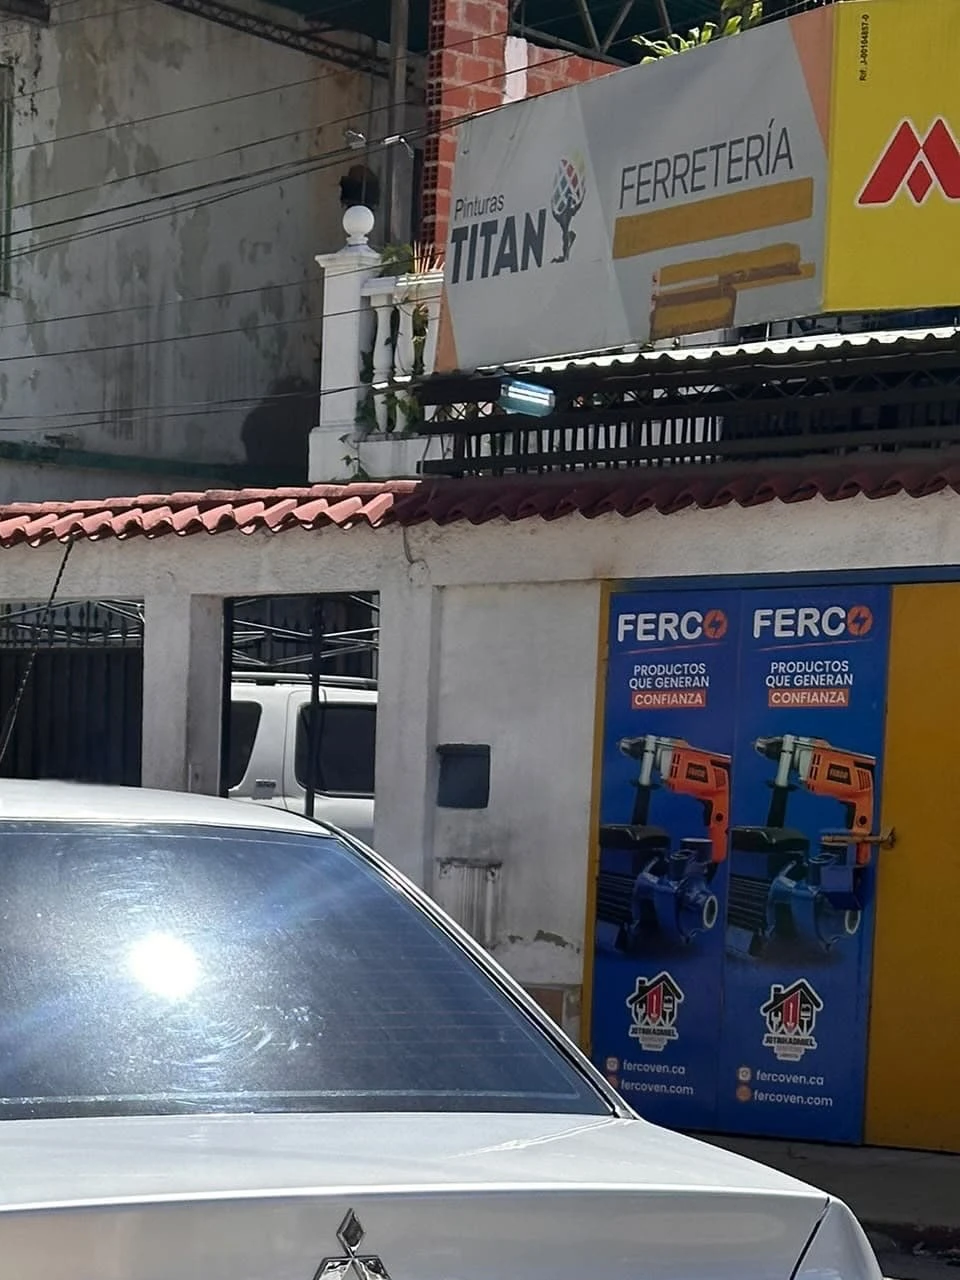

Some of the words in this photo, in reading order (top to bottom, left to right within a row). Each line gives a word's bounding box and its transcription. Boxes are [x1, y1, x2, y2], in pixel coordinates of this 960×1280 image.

[617, 118, 795, 210] FERRETERÍA
[454, 194, 505, 222] Pinturas
[450, 208, 548, 285] TITAN
[617, 609, 728, 642] FERCO
[752, 605, 873, 639] FERCO
[633, 662, 706, 676] PRODUCTOS
[770, 660, 849, 674] PRODUCTOS
[628, 676, 652, 689] QUE
[655, 675, 710, 689] GENERAN
[765, 674, 792, 688] QUE
[793, 673, 854, 687] GENERAN
[634, 693, 703, 706] CONFIANZA
[771, 691, 846, 705] CONFIANZA
[622, 1059, 686, 1075] fercoven.ca
[756, 1069, 824, 1086] fercoven.ca
[620, 1080, 694, 1096] fercoven.com
[753, 1089, 833, 1107] fercoven.com
